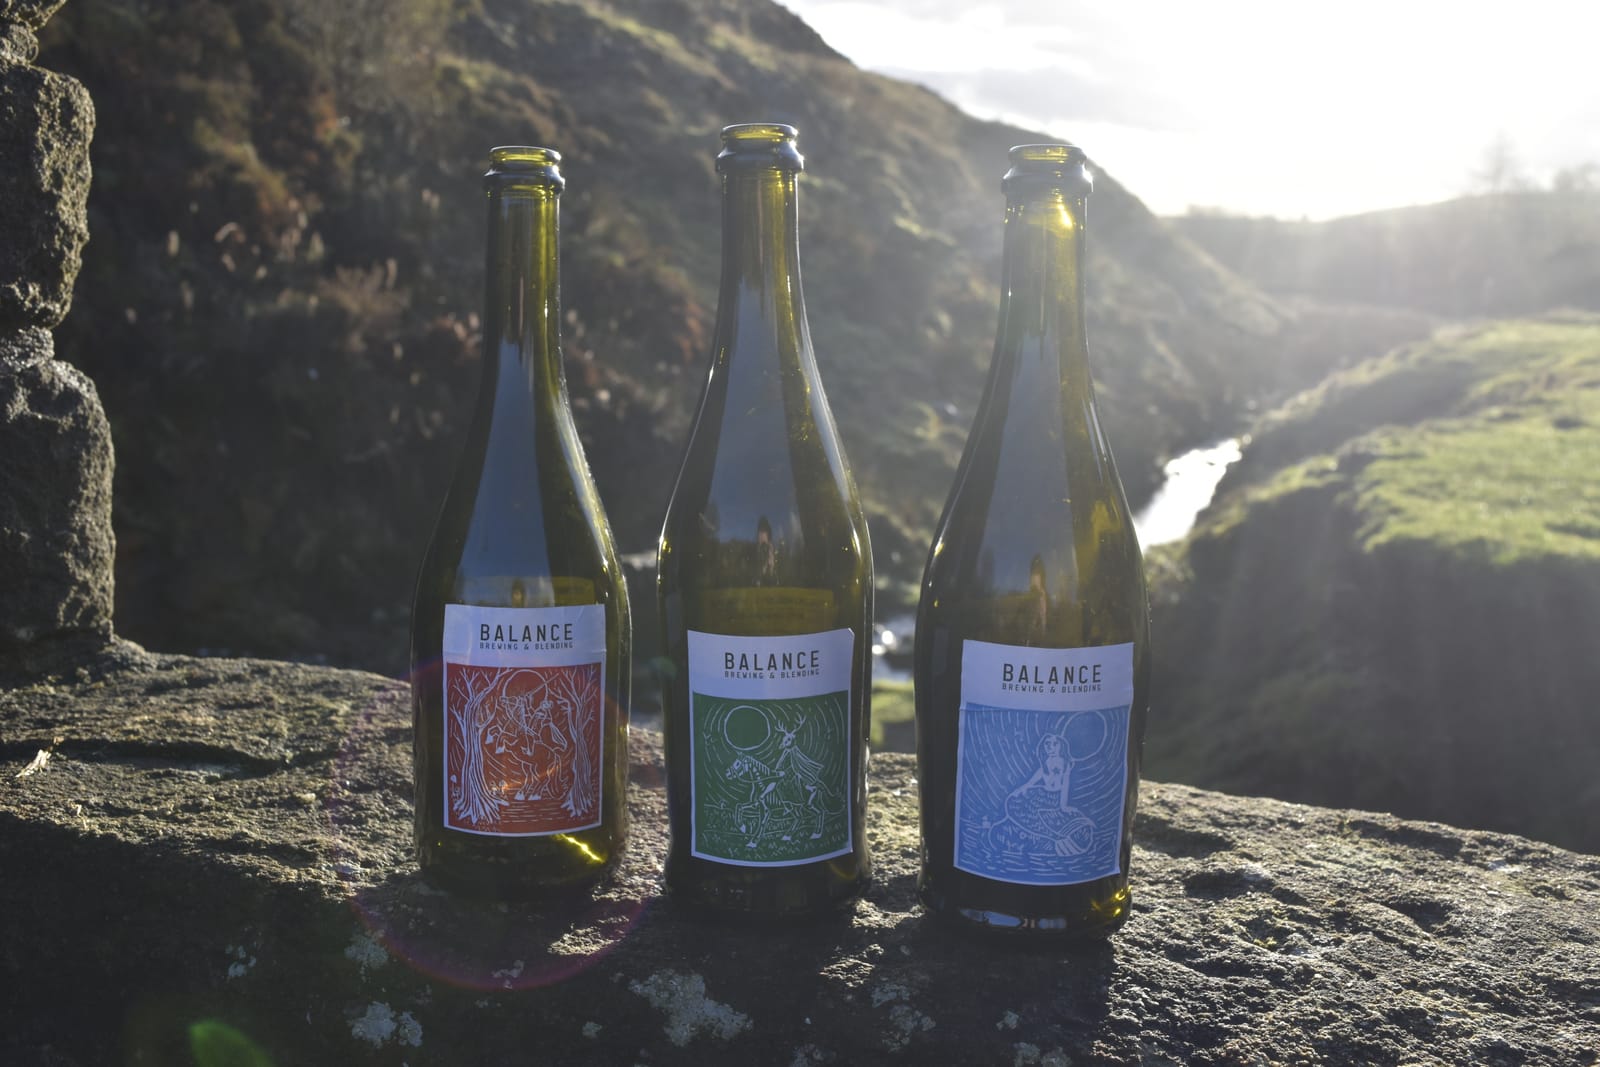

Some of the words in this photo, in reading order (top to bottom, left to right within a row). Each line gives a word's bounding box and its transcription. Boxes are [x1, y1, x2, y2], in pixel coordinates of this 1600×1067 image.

[480, 623, 573, 642] BALANCE
[480, 641, 518, 650] BREWING
[535, 642, 573, 650] BLENDING
[724, 650, 820, 671] BALANCE
[724, 671, 764, 679] BREWING
[769, 671, 775, 679] &
[780, 668, 820, 679] BLENDING
[1003, 663, 1102, 685] BALANCE
[1002, 682, 1044, 694] BREWING
[1050, 686, 1056, 694] &
[1061, 684, 1101, 694] BLENDING
